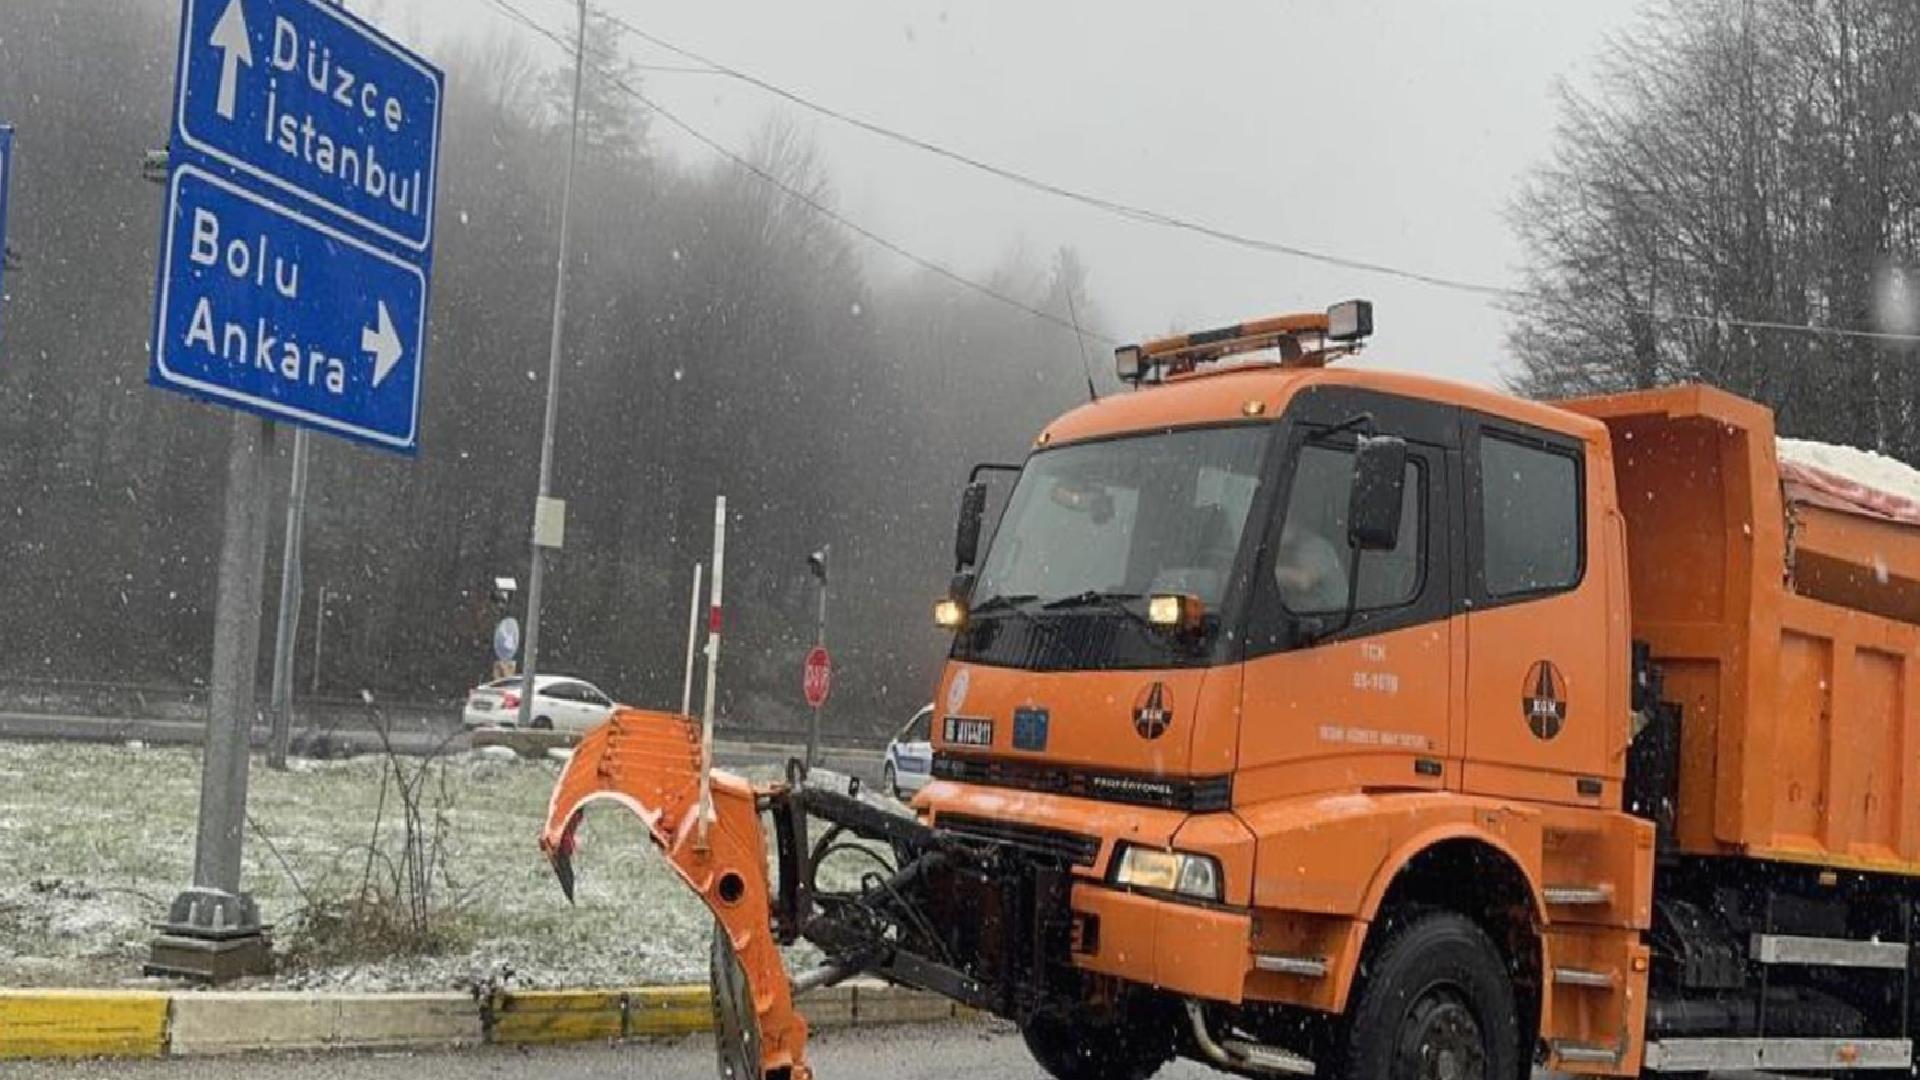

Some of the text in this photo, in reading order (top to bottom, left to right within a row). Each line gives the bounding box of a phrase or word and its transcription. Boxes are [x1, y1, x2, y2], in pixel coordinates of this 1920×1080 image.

[272, 16, 403, 131] Düzce
[265, 79, 420, 216] İstanbul
[189, 207, 299, 297] Bolu
[184, 297, 345, 394] Ankara
